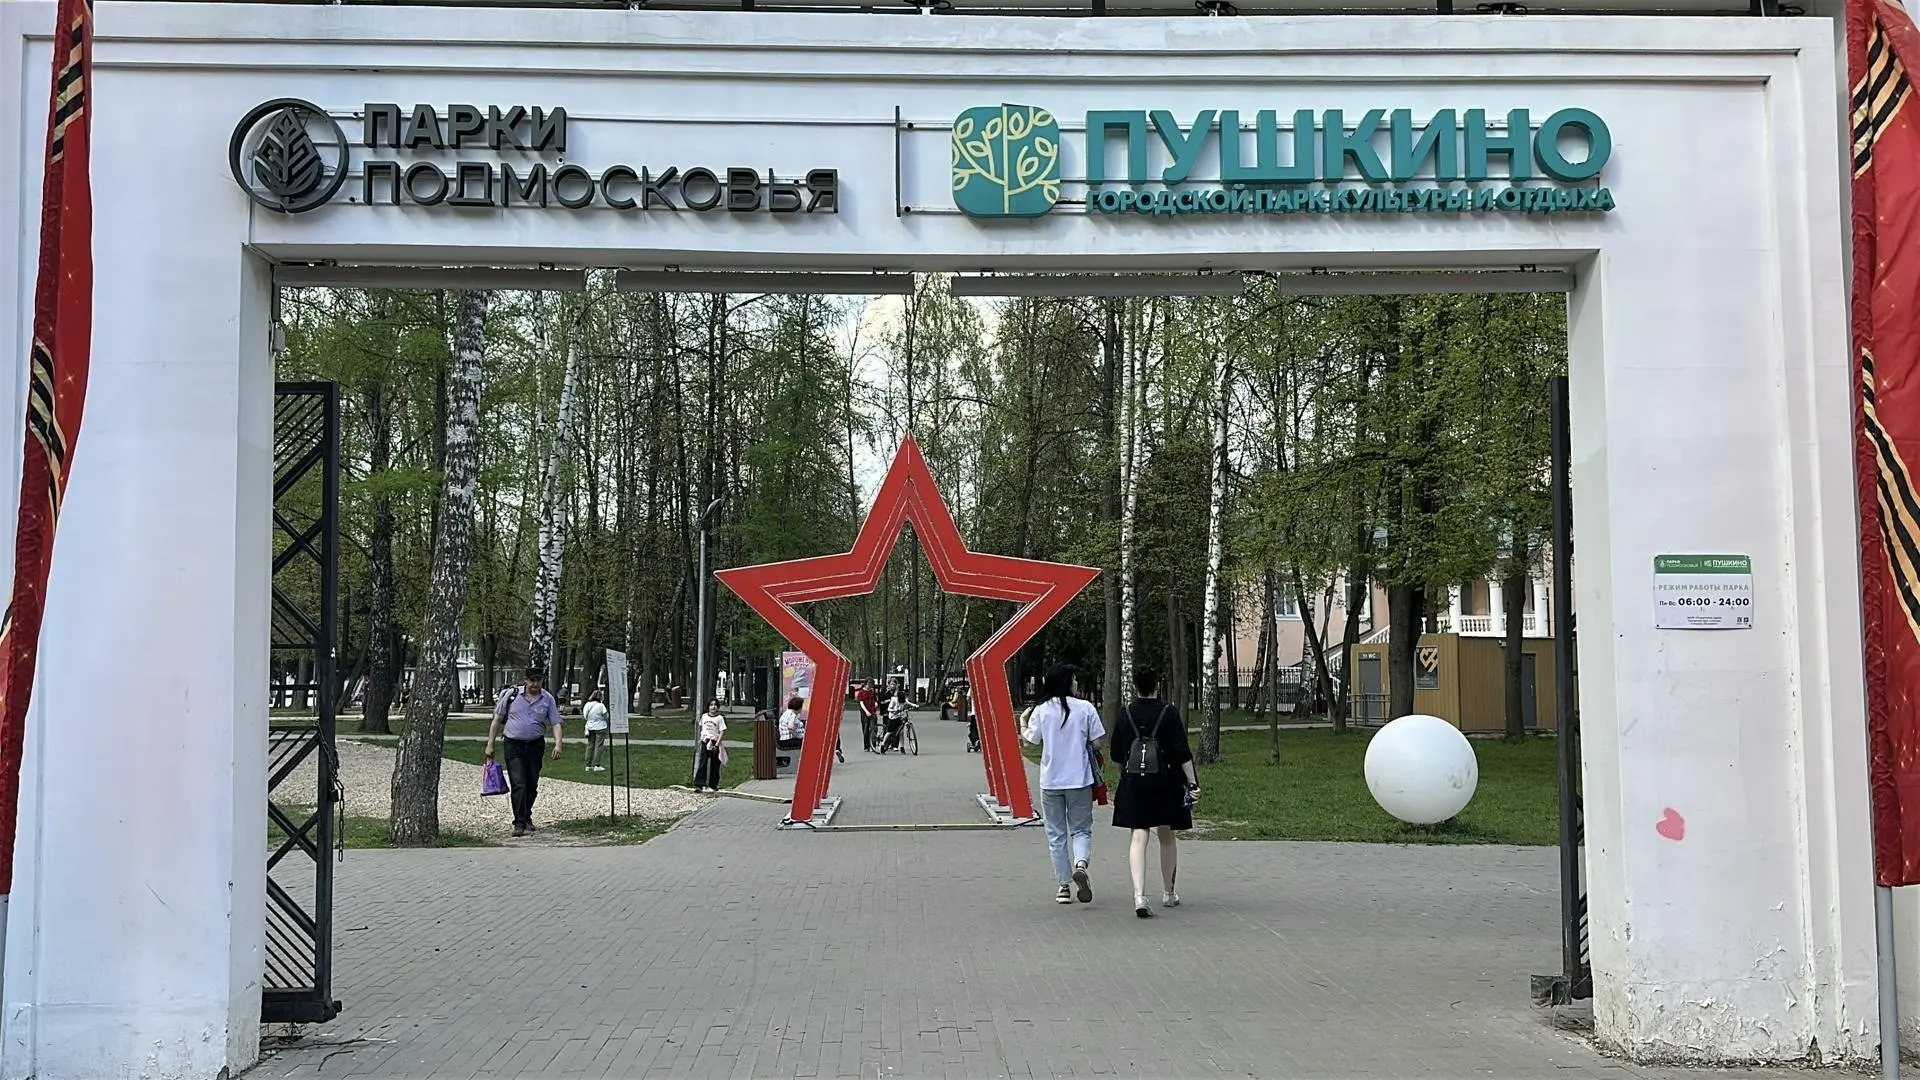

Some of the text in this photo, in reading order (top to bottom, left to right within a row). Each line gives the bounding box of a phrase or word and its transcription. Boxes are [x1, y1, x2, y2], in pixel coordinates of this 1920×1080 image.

[364, 103, 567, 152] ПАРКИ
[1086, 107, 1612, 186] ПУШКИНО
[363, 160, 839, 214] ПОДМОСКОВЬЯ
[1086, 184, 1616, 215] ГОРОДСКОЙ ПАРК КУЛЬТУРЫ И ОТДЫХА
[1712, 559, 1748, 567] ПУШКИНО
[1678, 597, 1711, 606] 06:00
[1718, 597, 1750, 606] 24:00
